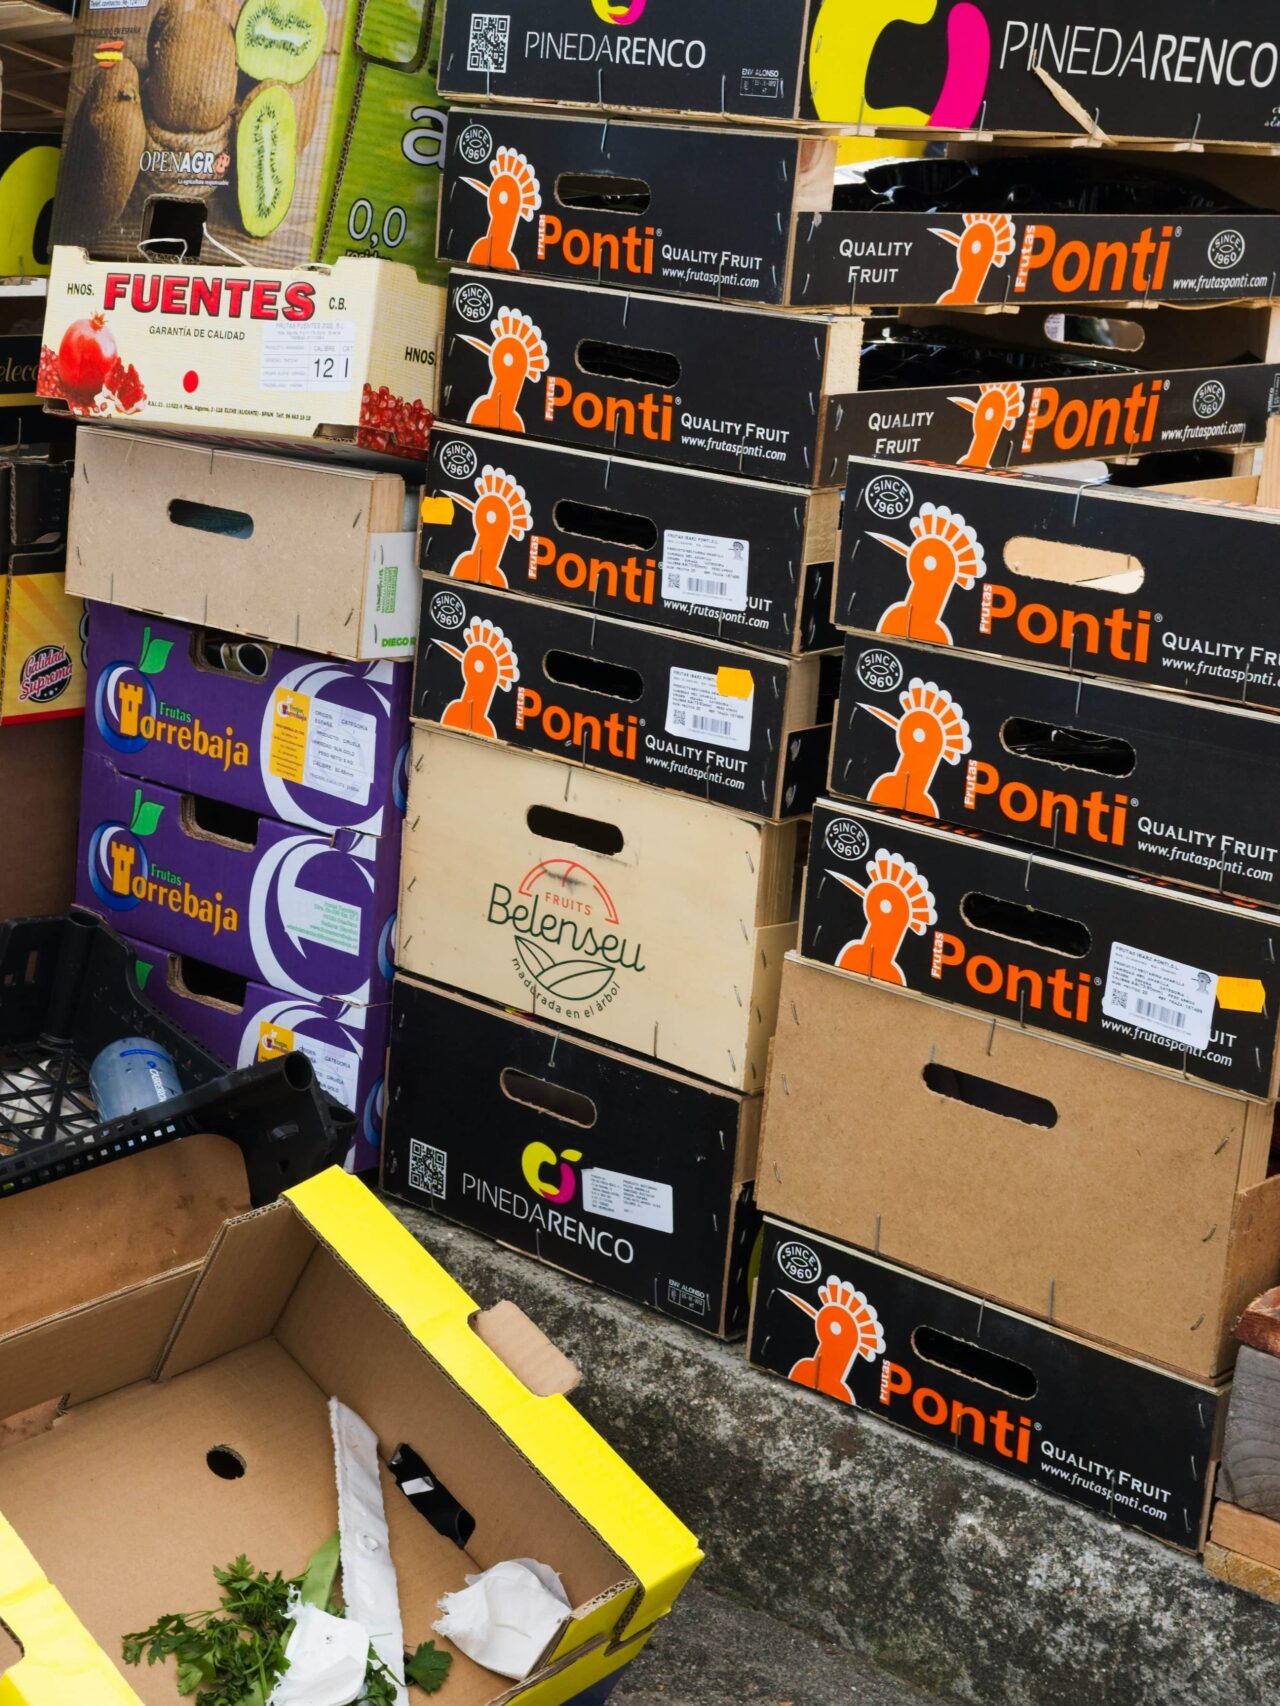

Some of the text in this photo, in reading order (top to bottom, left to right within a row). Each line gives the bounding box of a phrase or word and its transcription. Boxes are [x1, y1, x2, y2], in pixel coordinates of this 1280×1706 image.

[525, 31, 706, 69] PINEDARENCO
[999, 20, 1280, 88] PINEDARENCO
[464, 128, 489, 145] SINCE
[464, 146, 487, 161] 1960
[347, 197, 408, 248] 0,0
[537, 214, 654, 275] Ponti
[838, 239, 913, 258] QUALITY
[1213, 234, 1242, 250] SINCE
[662, 244, 763, 271] QUALITY FRUIT
[1014, 224, 1037, 291] Frutas
[1014, 224, 1174, 294] Ponti
[1214, 251, 1239, 267] 1960
[662, 265, 760, 290] www.frutasponti.com
[847, 265, 899, 284] FRUIT
[1173, 274, 1268, 293] www.frutasponti.com
[67, 272, 347, 322] HNOS. FUENTES C.B.
[461, 287, 490, 303] SINCE
[462, 305, 486, 320] 1960
[149, 325, 245, 341] GARANTÍA DE CALIDAD
[314, 358, 334, 378] 12
[405, 346, 436, 366] HNOS.
[1197, 384, 1223, 401] SINCE
[544, 376, 674, 442] Ponti
[868, 411, 934, 431] QUALITY
[1021, 380, 1163, 454] Ponti
[1021, 386, 1041, 452] Frutas
[1198, 401, 1219, 416] 1960
[681, 413, 790, 444] QUALITY FRUIT
[1160, 422, 1245, 443] www.frutasponti.com
[444, 445, 474, 461] SINCE
[681, 433, 787, 463] www.frutasponti.com
[875, 437, 920, 455] FRUIT
[446, 462, 471, 478] 1960
[873, 477, 910, 496] SINCE
[874, 498, 904, 517] 1960
[528, 535, 540, 580] Frutas
[528, 535, 656, 606] Ponti
[434, 594, 463, 611] SINCE
[663, 598, 770, 631] www.frutasponti.com
[979, 582, 994, 634] Frutas
[435, 611, 461, 627] 1960
[979, 583, 1152, 664] Ponti
[381, 637, 409, 648] DIEGO
[1161, 631, 1246, 661] QUALITY
[24, 645, 66, 679] Calidad
[862, 651, 899, 672] SINCE
[19, 663, 73, 702] Suprema
[864, 670, 894, 688] 1960
[160, 701, 192, 723] Frutas
[515, 686, 526, 731] Frutas
[515, 686, 638, 762] Ponti
[645, 734, 748, 775] QUALITY FRUIT
[645, 755, 746, 792] www.frutasponti.com
[964, 759, 978, 809] Frutas
[964, 760, 1129, 847] Ponti
[829, 821, 865, 842] SINCE
[1138, 815, 1279, 864] QUALITY FRUIT
[831, 839, 862, 857] 1960
[1137, 838, 1274, 883] www.frutasponti.com
[150, 863, 182, 886] Frutas
[545, 892, 592, 916] FRUITS
[487, 883, 646, 973] Belenseu
[931, 930, 945, 981] Frutas
[510, 956, 621, 1020] madurada en el árbol
[931, 931, 1102, 1024] Ponti
[1101, 1017, 1233, 1068] www.frutasponti.com
[463, 1171, 635, 1265] PINEDARENCO
[783, 1245, 818, 1267] SINCE
[785, 1261, 815, 1281] 1960
[880, 1358, 892, 1404] Frutas
[880, 1360, 1033, 1465] Ponti
[1040, 1440, 1172, 1504] QUALITY FRUIT
[1040, 1459, 1168, 1522] www.frutasponti.com
